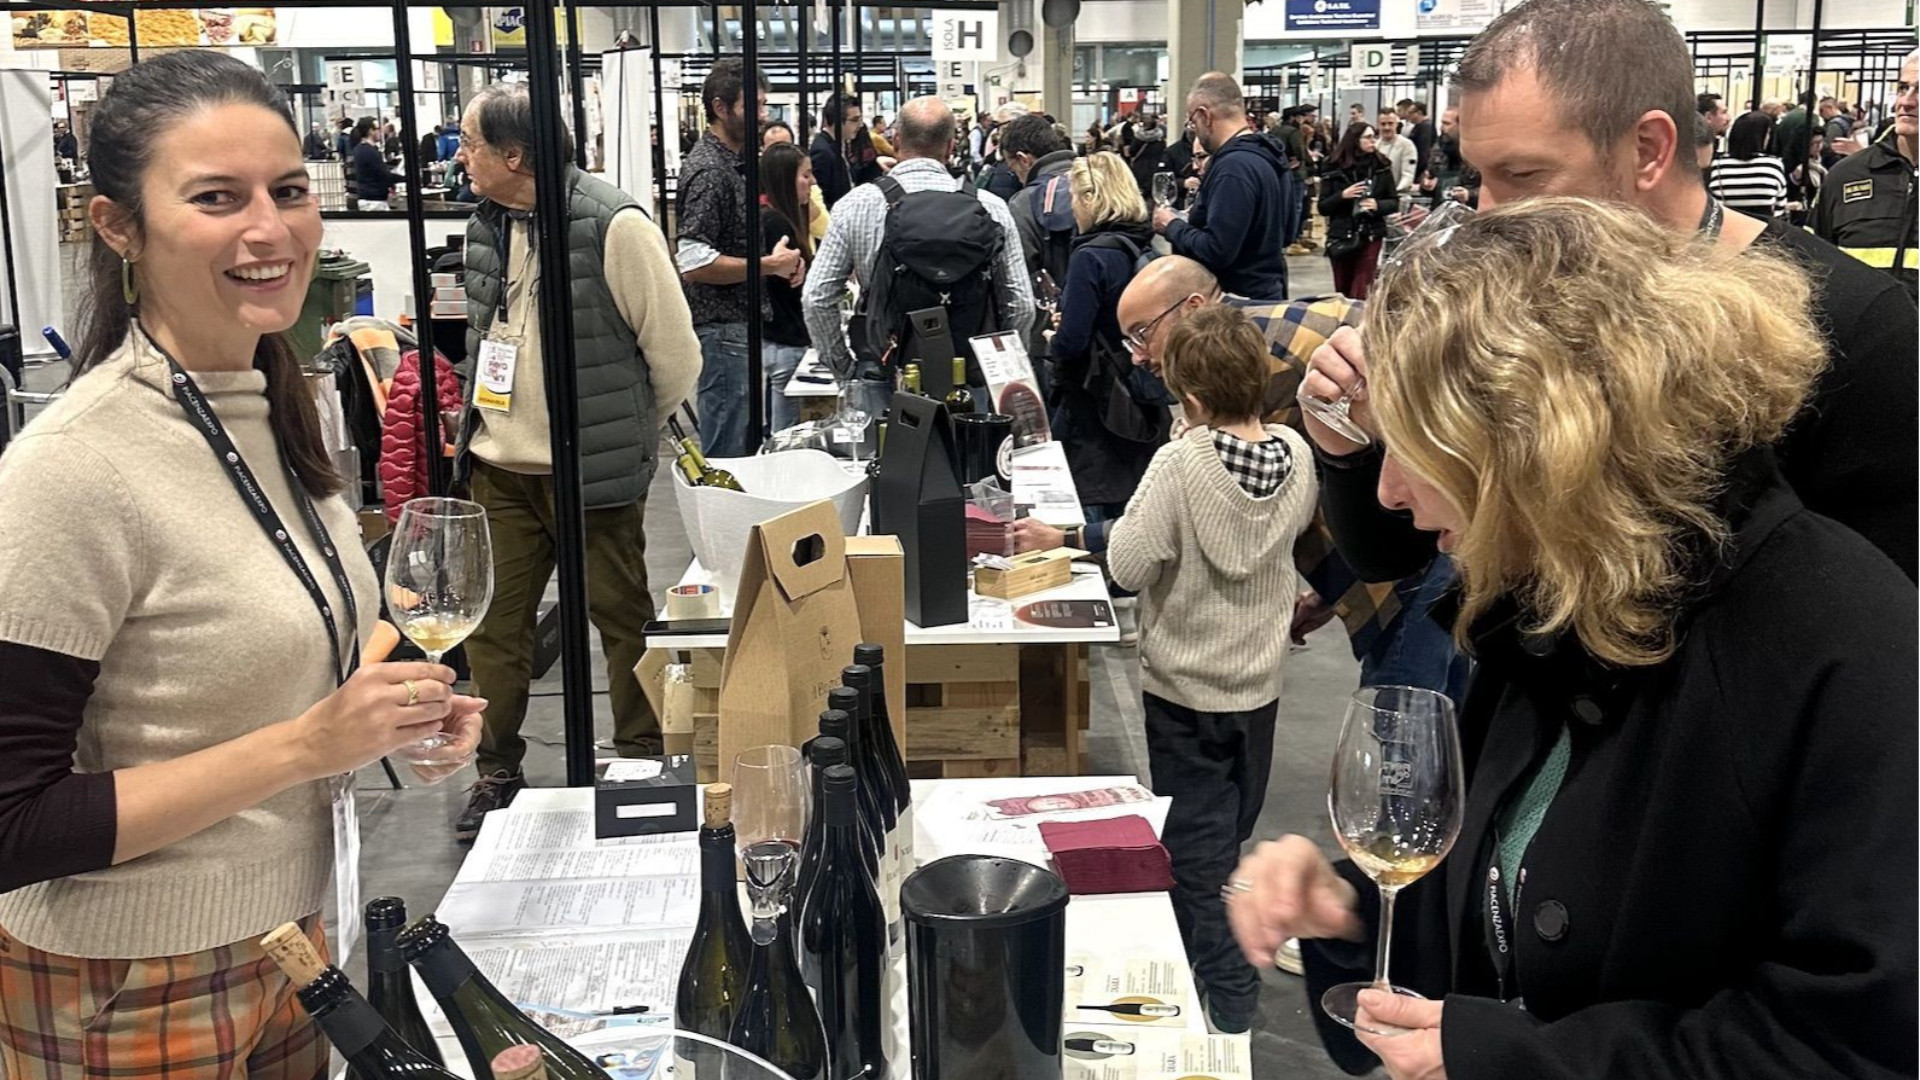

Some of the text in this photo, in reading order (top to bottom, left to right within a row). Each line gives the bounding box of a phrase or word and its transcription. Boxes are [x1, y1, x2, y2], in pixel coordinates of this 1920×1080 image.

[943, 18, 983, 50] ISOLA H
[951, 61, 962, 78] E
[1367, 50, 1384, 67] D
[341, 66, 354, 83] E
[181, 385, 219, 436] PIACENZAEXPO
[233, 464, 268, 514] PIACENZAEXPO
